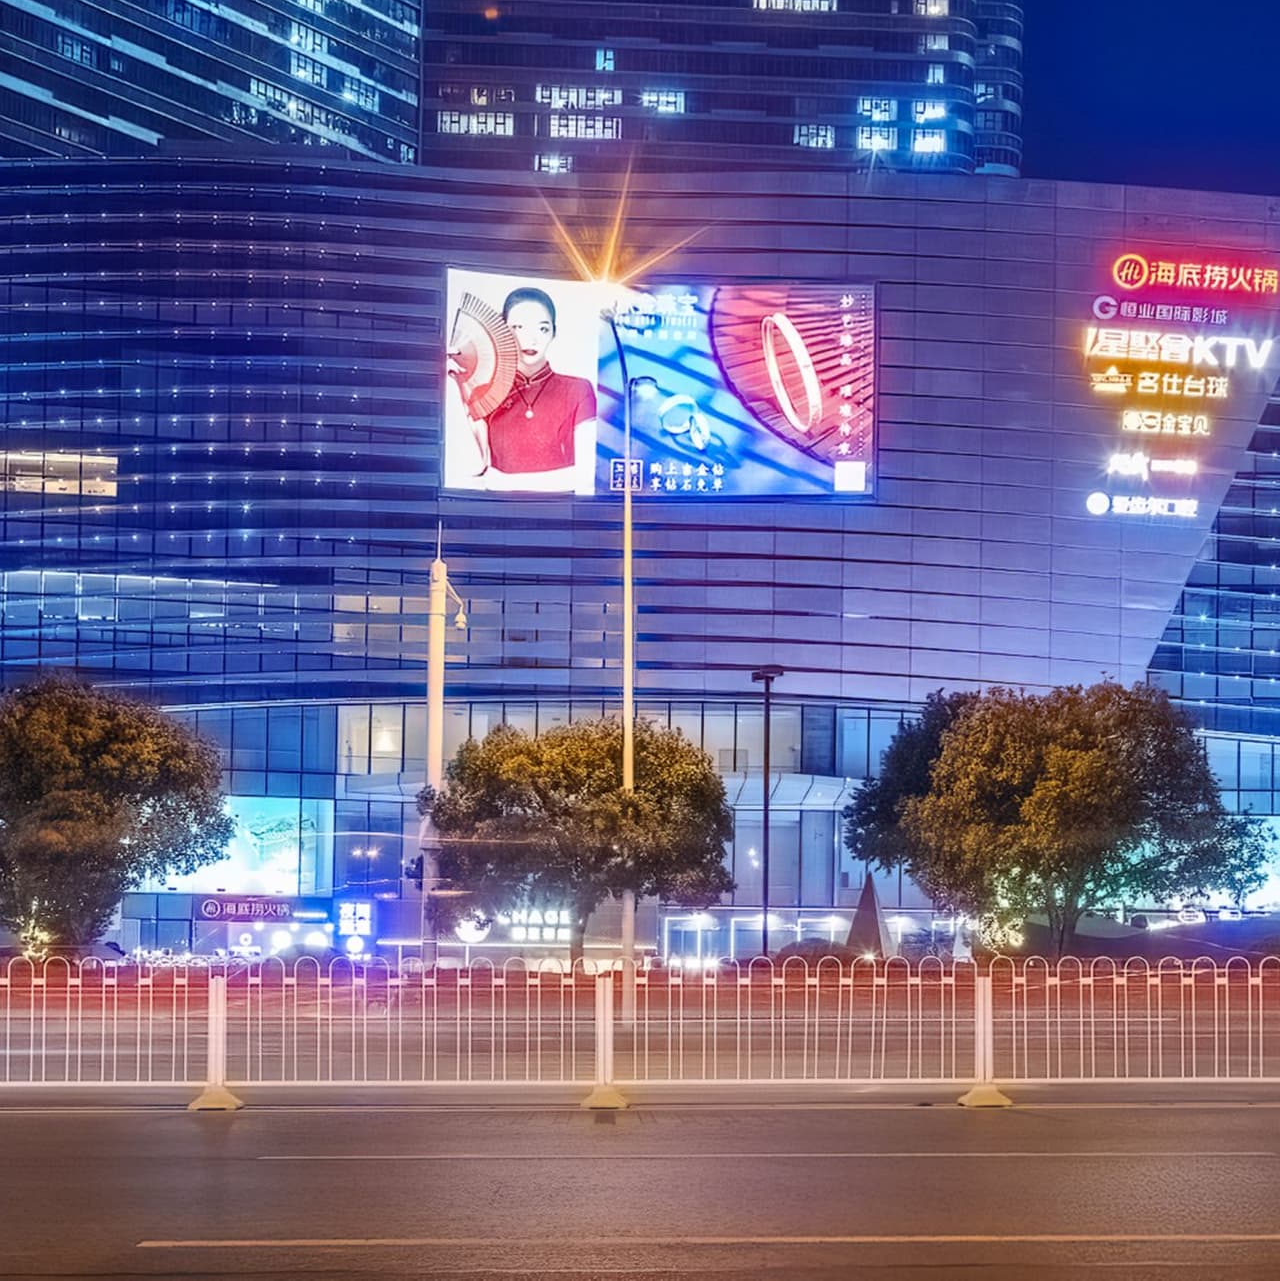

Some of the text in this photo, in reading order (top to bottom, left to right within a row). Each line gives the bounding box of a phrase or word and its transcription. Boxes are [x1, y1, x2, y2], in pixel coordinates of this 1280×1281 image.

[1148, 261, 1279, 293] 海底捞火锅
[1120, 302, 1229, 325] 恒业国际影城
[1137, 372, 1229, 398] 名仕台球
